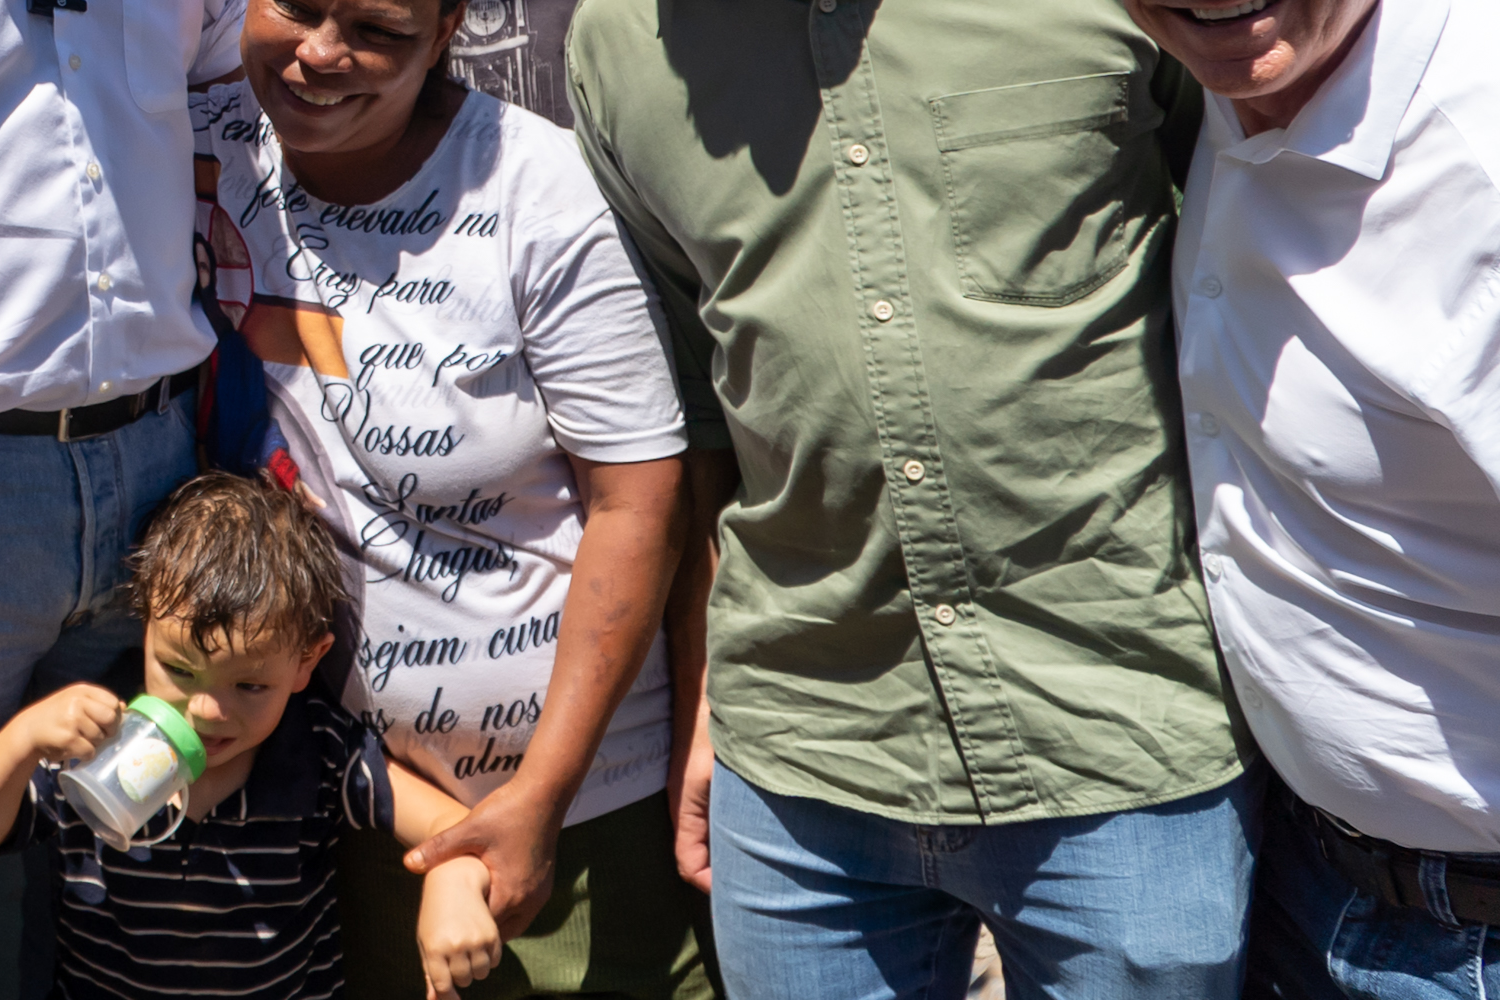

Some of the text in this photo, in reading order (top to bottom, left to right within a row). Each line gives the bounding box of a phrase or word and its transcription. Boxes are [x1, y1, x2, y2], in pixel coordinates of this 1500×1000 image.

[320, 189, 447, 236] elevado
[454, 211, 499, 238] na
[366, 270, 456, 314] para
[357, 342, 427, 392] que
[432, 344, 507, 387] por
[321, 383, 465, 457] Vossas
[359, 625, 467, 692] sejam
[415, 687, 460, 735] de
